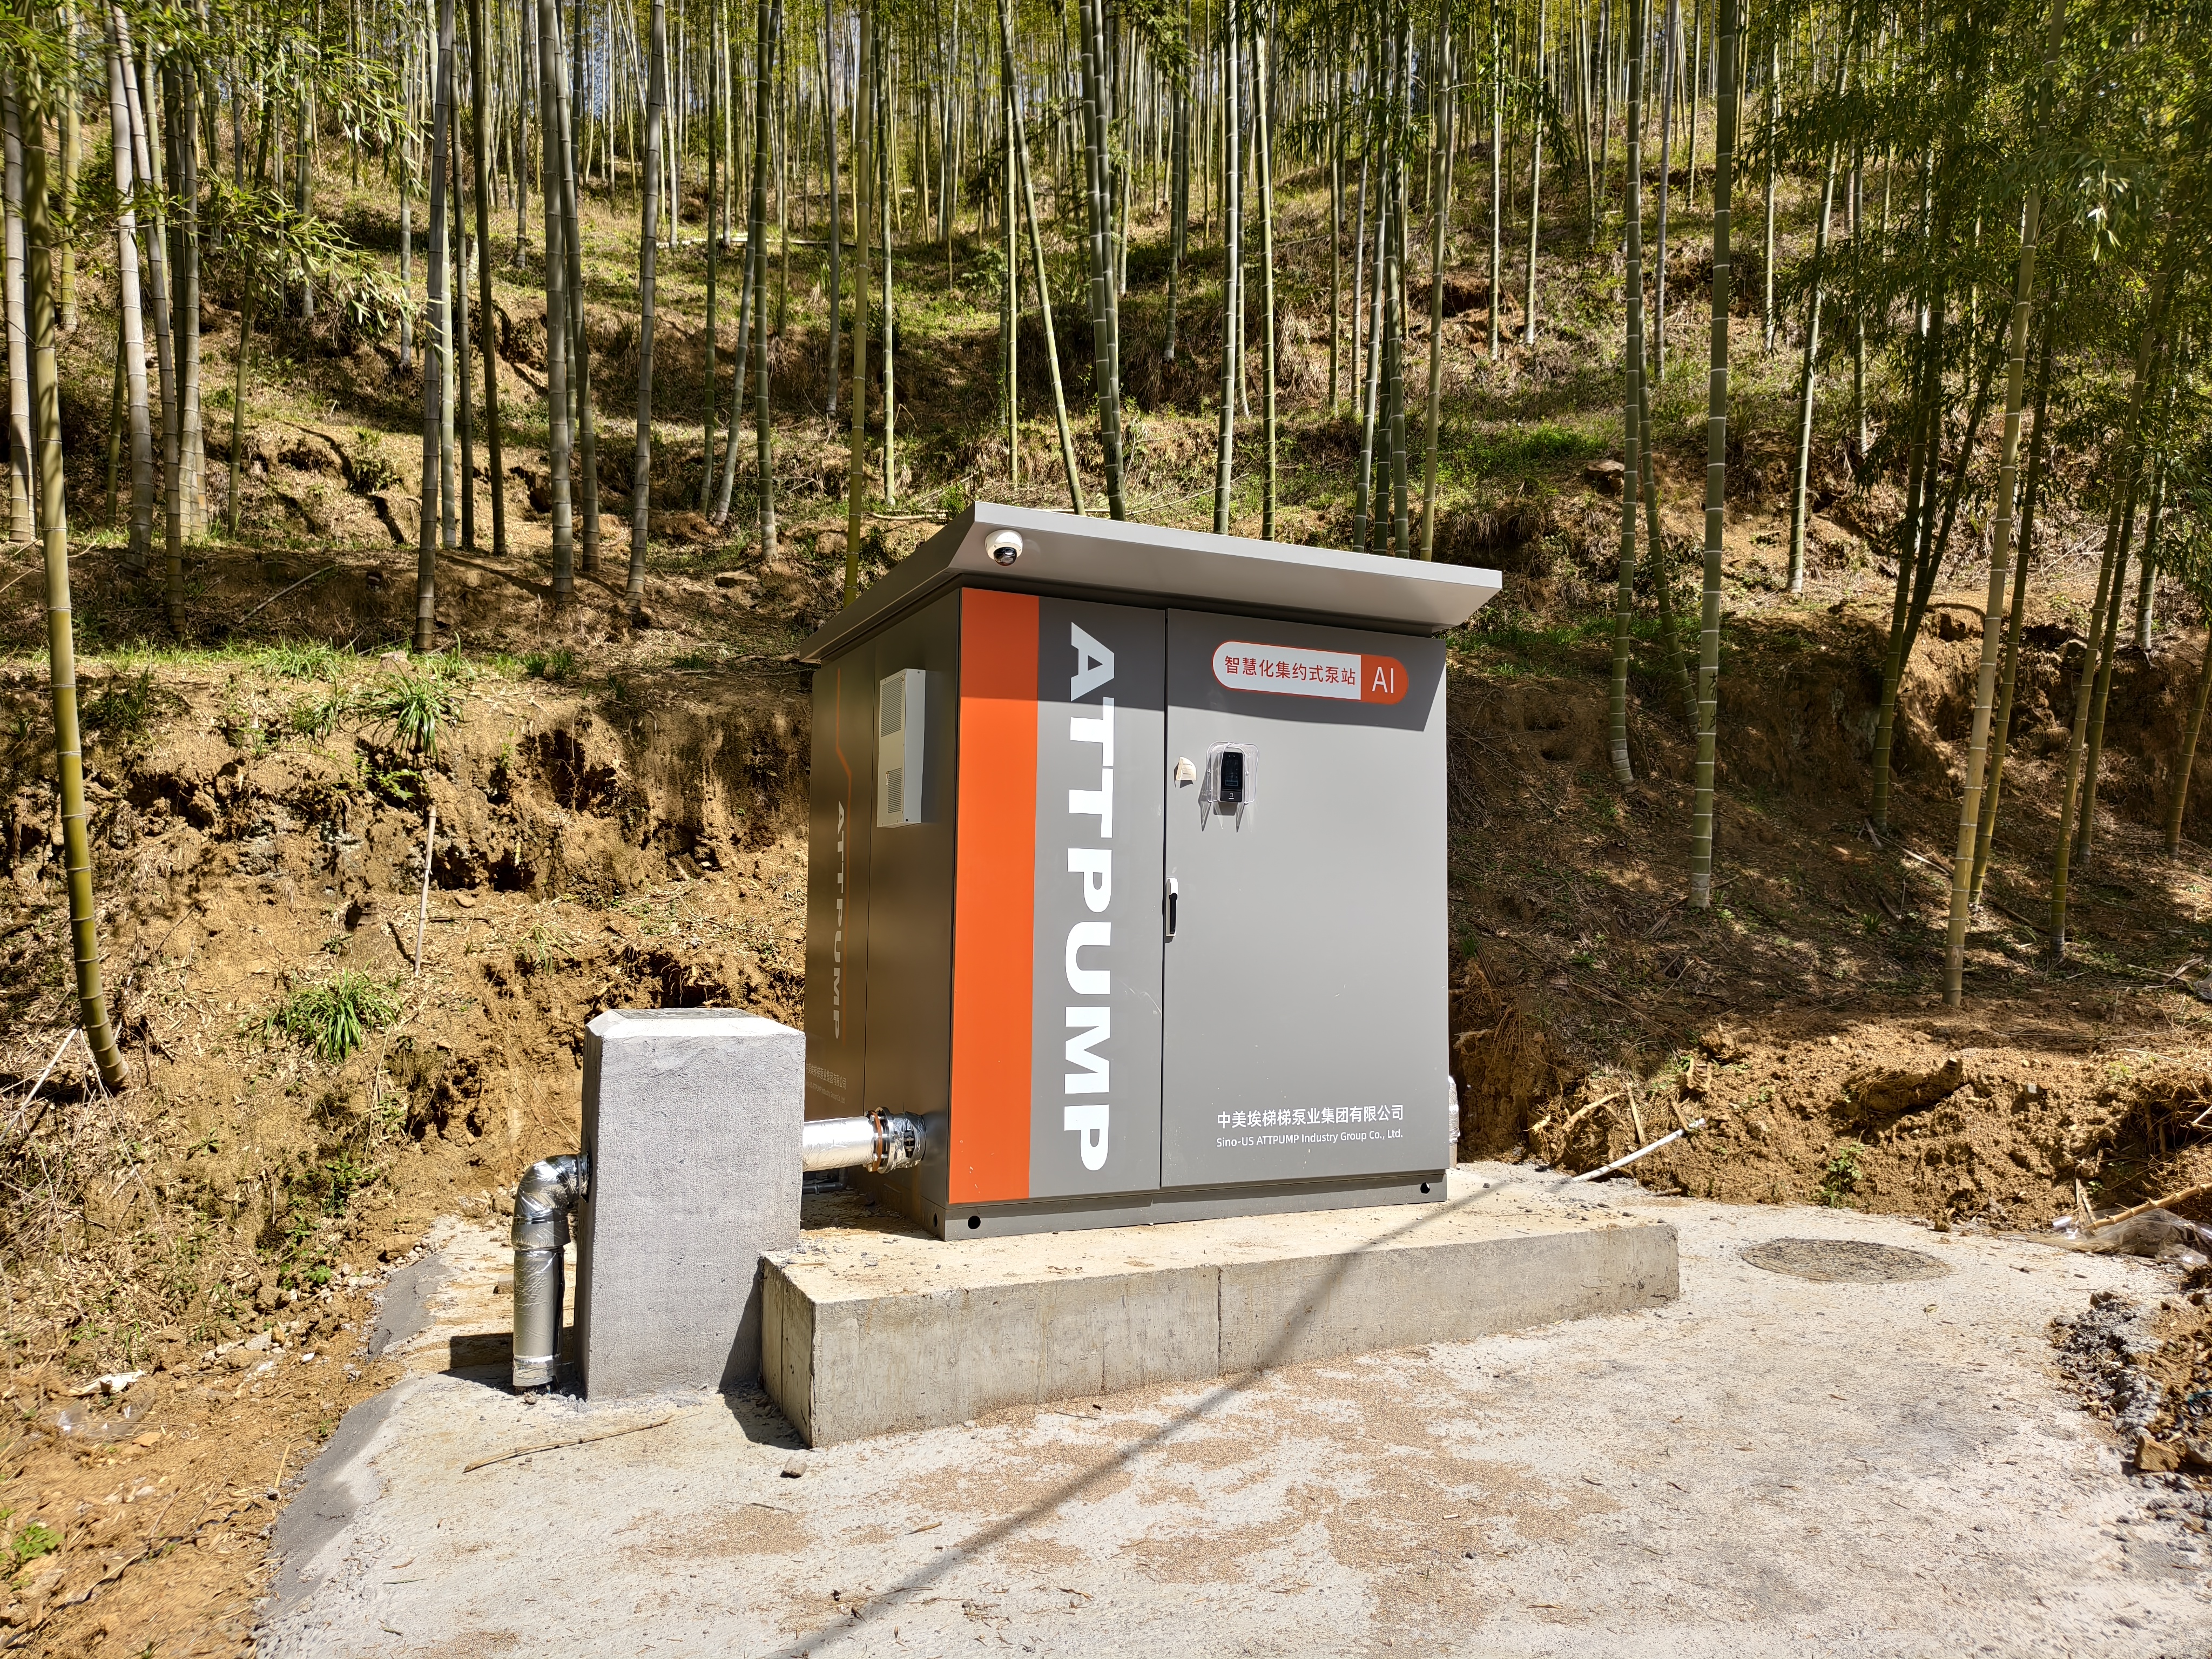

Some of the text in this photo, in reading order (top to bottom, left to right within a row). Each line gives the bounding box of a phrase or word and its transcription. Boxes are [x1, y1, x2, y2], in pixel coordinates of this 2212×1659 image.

[1224, 655, 1356, 686] 智慧化集约式泵站
[1372, 666, 1394, 693] AI
[1064, 622, 1115, 1171] ATTPUMP
[833, 800, 845, 1040] ATTPUMP
[1217, 1104, 1404, 1129] 中美埃梯梯泵业集团有限公司
[1216, 1128, 1403, 1147] Sino-US ATTPUMP Industry Group Co., Ltd.
